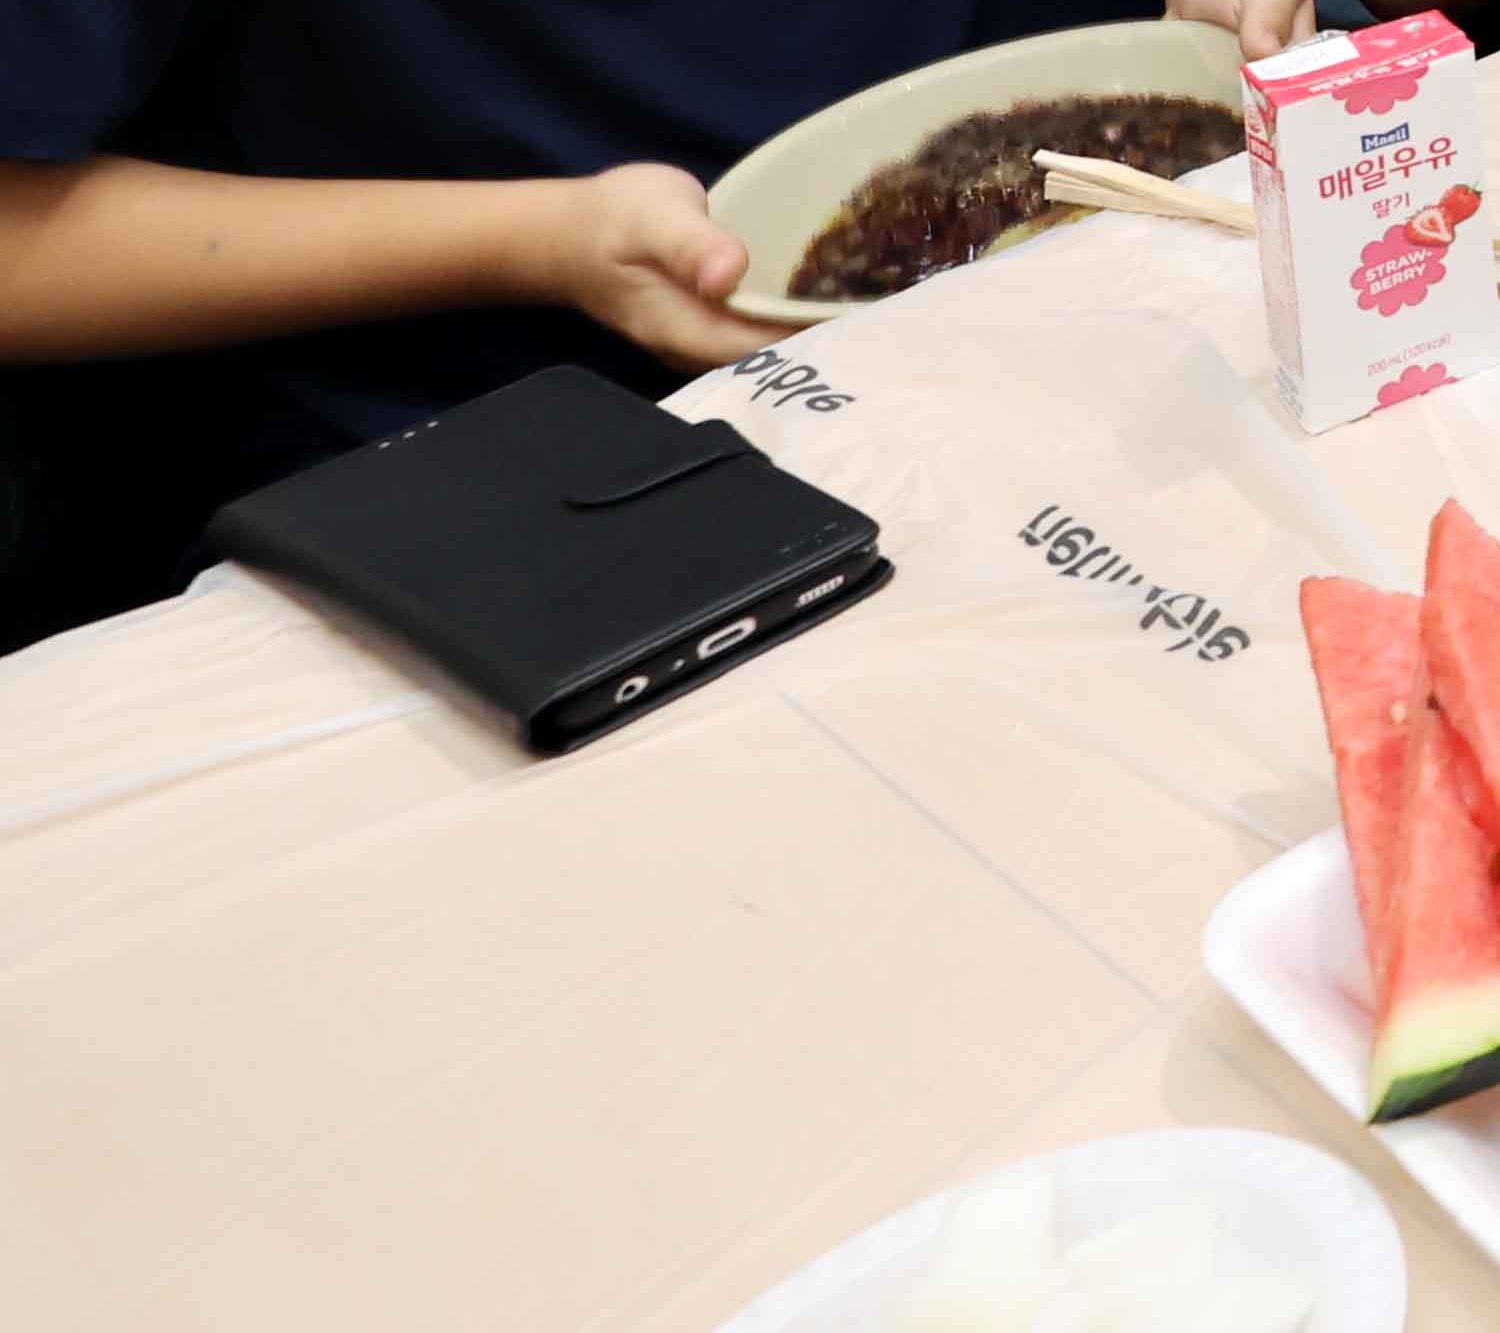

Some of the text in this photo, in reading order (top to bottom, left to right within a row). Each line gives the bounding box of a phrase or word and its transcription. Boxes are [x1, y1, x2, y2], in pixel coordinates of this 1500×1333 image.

[1364, 126, 1409, 151] Maeil
[1319, 136, 1458, 200] 매일우유
[1372, 193, 1411, 219] 딸기
[1365, 249, 1433, 282] STRAW-
[1370, 263, 1427, 295] BERRY
